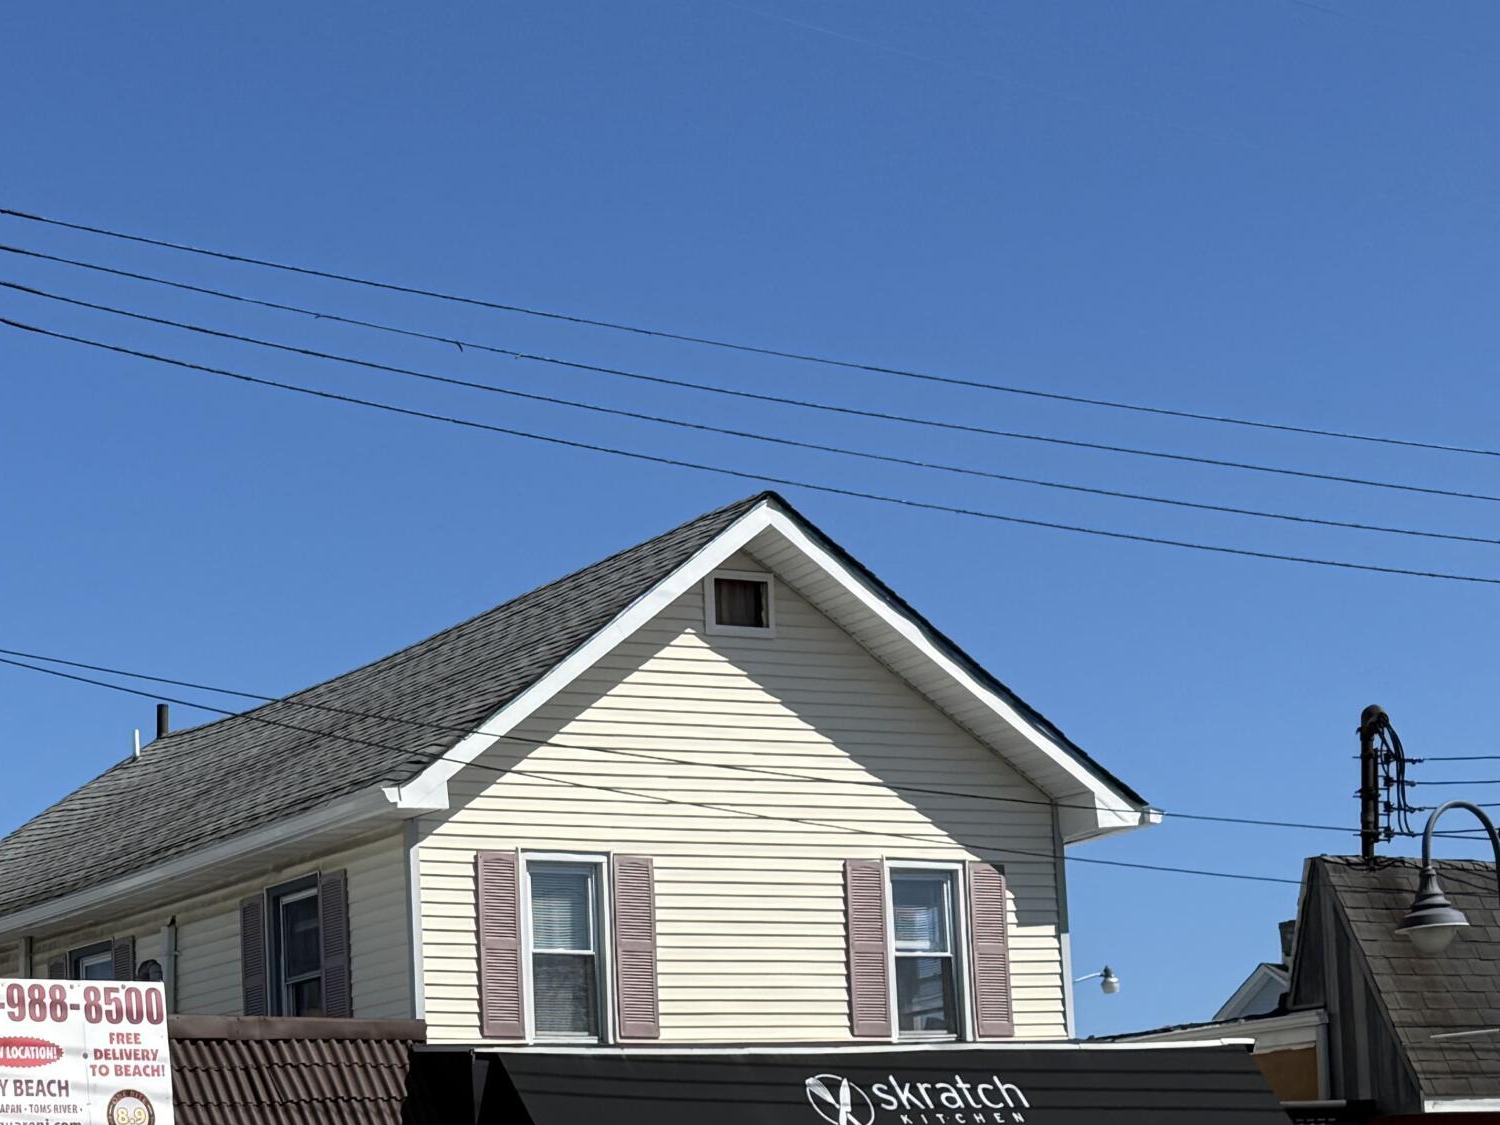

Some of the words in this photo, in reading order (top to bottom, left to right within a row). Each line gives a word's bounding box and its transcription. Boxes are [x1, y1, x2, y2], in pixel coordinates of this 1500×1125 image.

[109, 1032, 141, 1045] FREE
[6, 1045, 57, 1060] LOCATION!
[93, 1048, 159, 1062] DELIVERY
[90, 1064, 110, 1077] TO
[114, 1064, 166, 1077] BEACH!
[13, 1079, 70, 1097] BEACH
[871, 1074, 1031, 1111] skratch
[29, 1103, 52, 1113] TOMS
[53, 1104, 78, 1113] RIVER
[116, 1107, 149, 1125] 8.9
[900, 1112, 1026, 1125] KITCHEN
